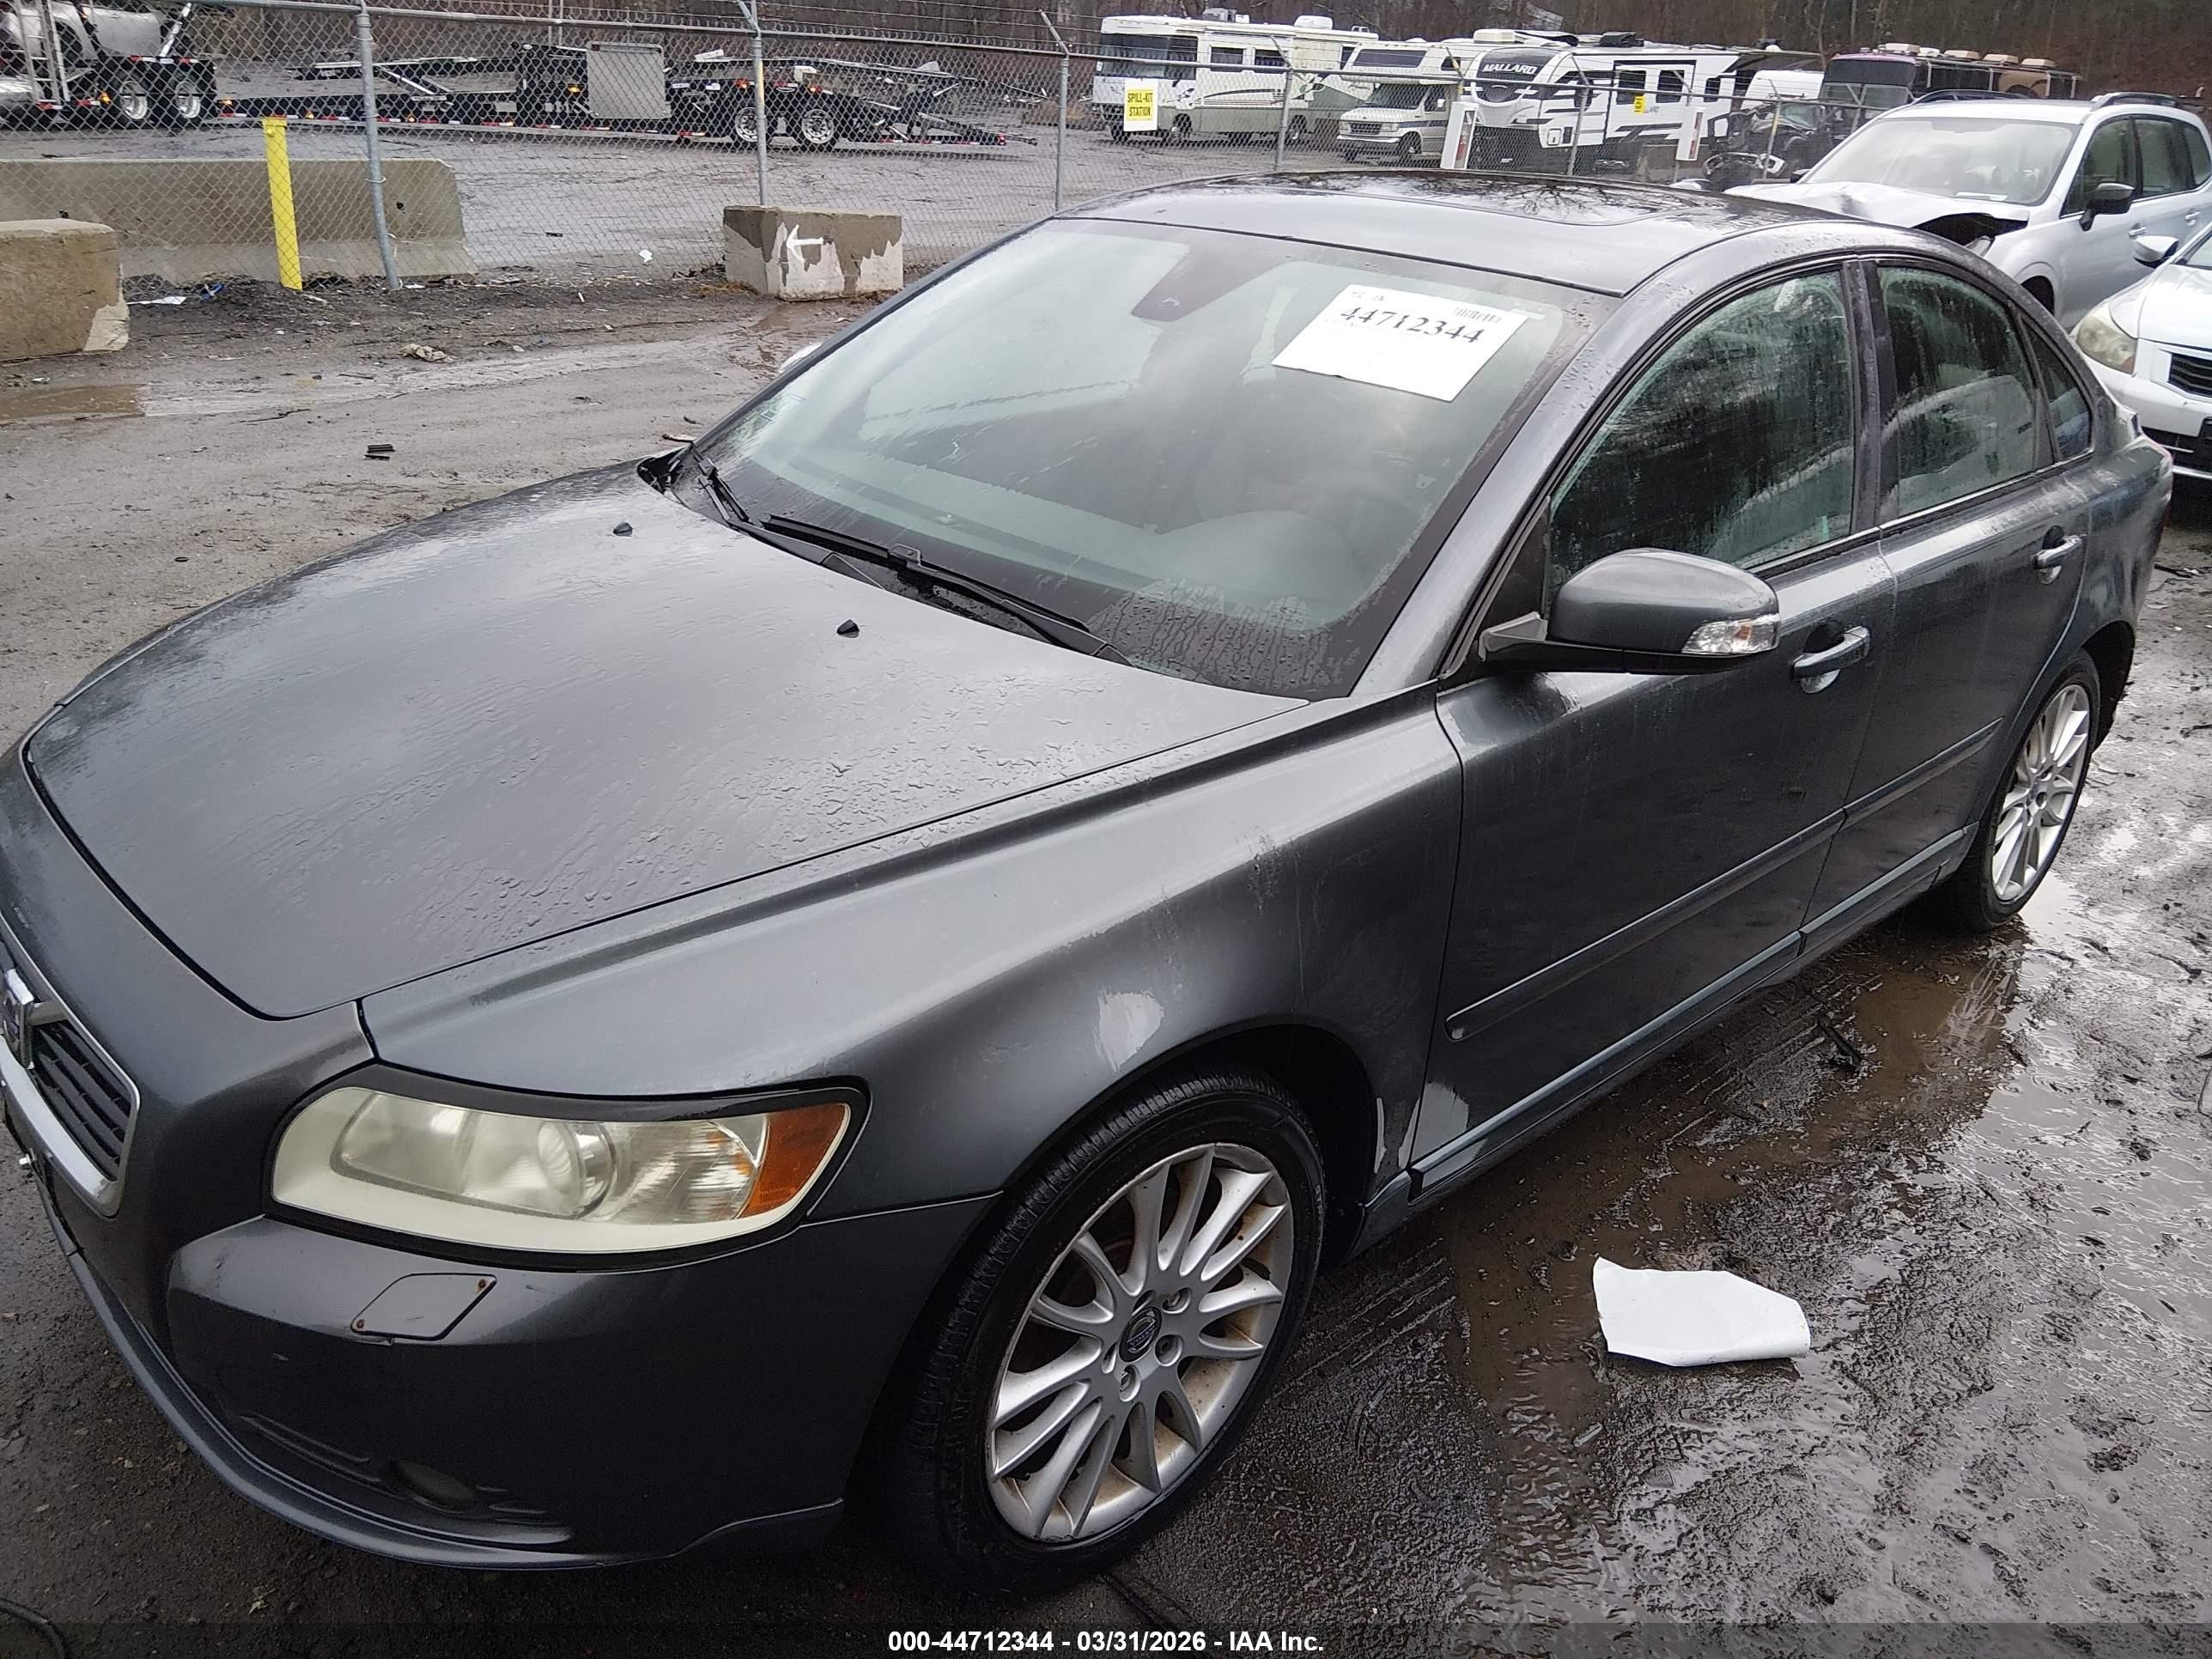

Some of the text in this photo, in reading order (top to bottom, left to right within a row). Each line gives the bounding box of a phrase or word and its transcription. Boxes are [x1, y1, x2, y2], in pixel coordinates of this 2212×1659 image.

[1482, 64, 1538, 75] MALLARD
[1127, 92, 1153, 103] SPILL-KIT
[1128, 106, 1151, 117] STATION
[1340, 307, 1485, 343] 44712344
